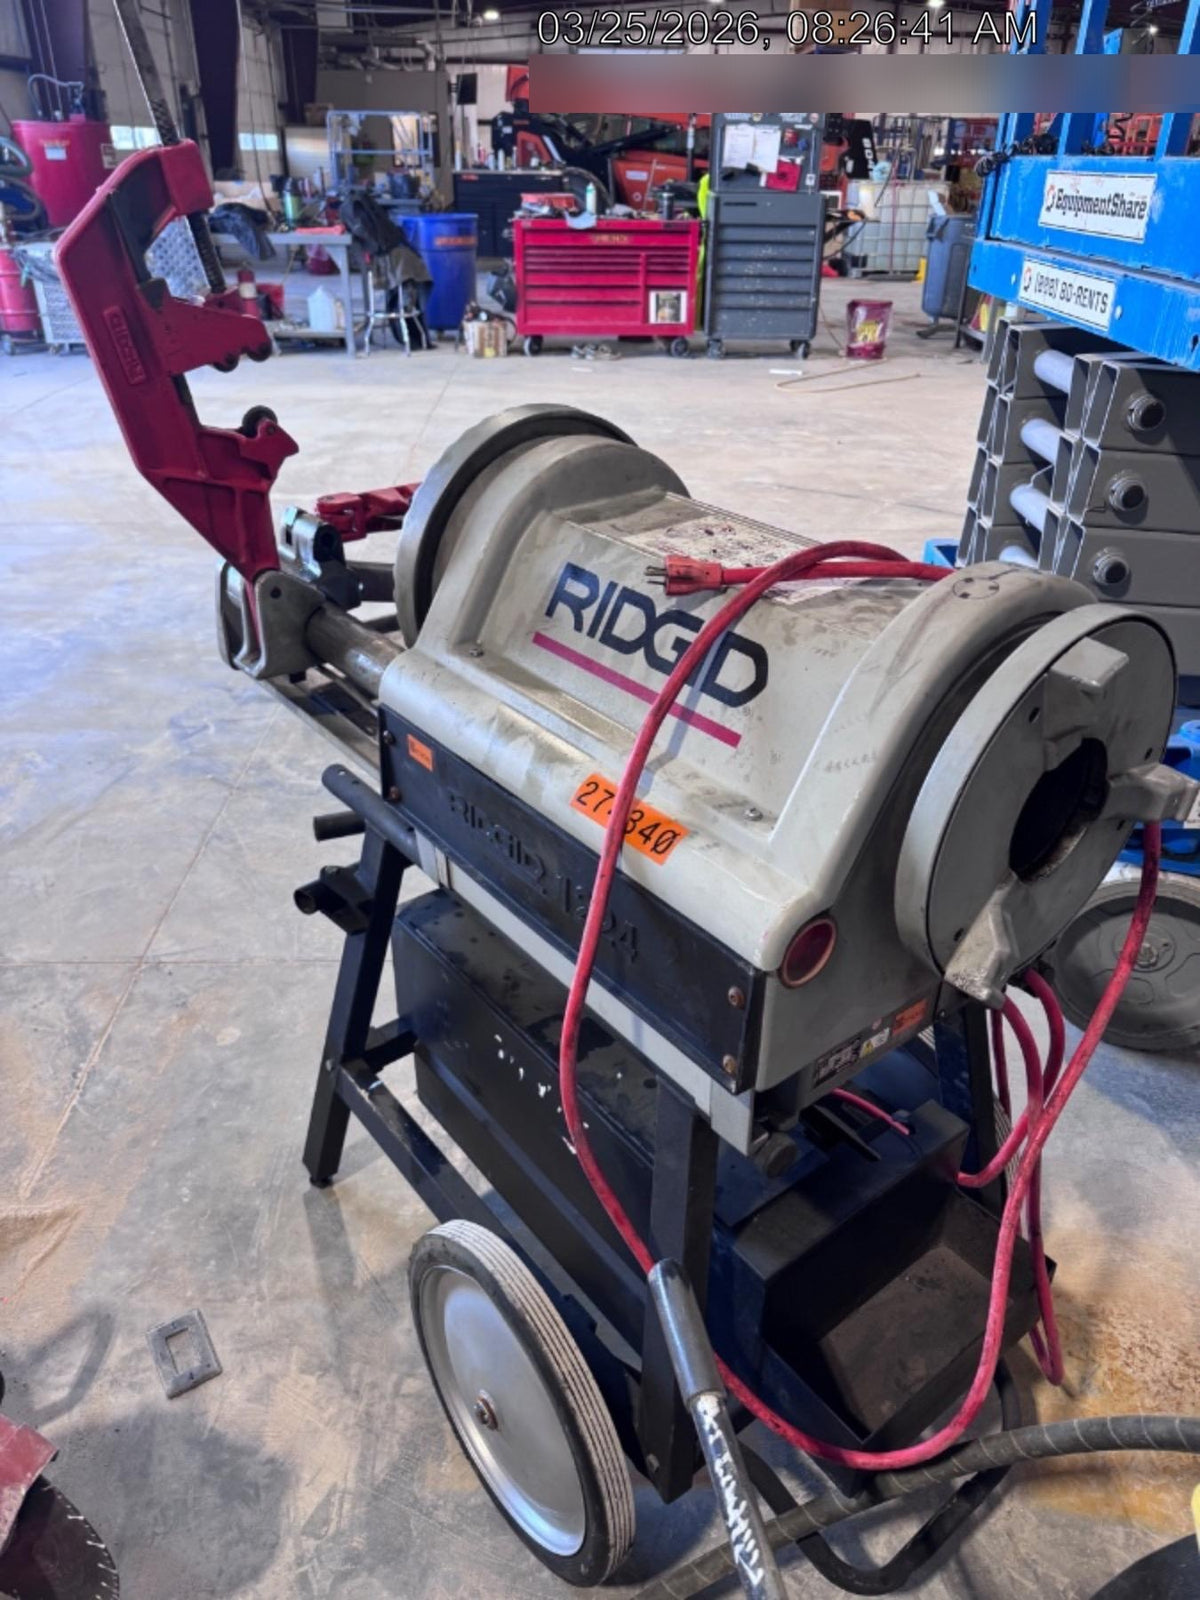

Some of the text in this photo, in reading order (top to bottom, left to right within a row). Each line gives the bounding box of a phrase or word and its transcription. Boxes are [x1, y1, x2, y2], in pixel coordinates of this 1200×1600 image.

[1054, 187, 1148, 220] EquipmentShare
[545, 562, 769, 708] RIDGD
[577, 782, 681, 855] 27340
